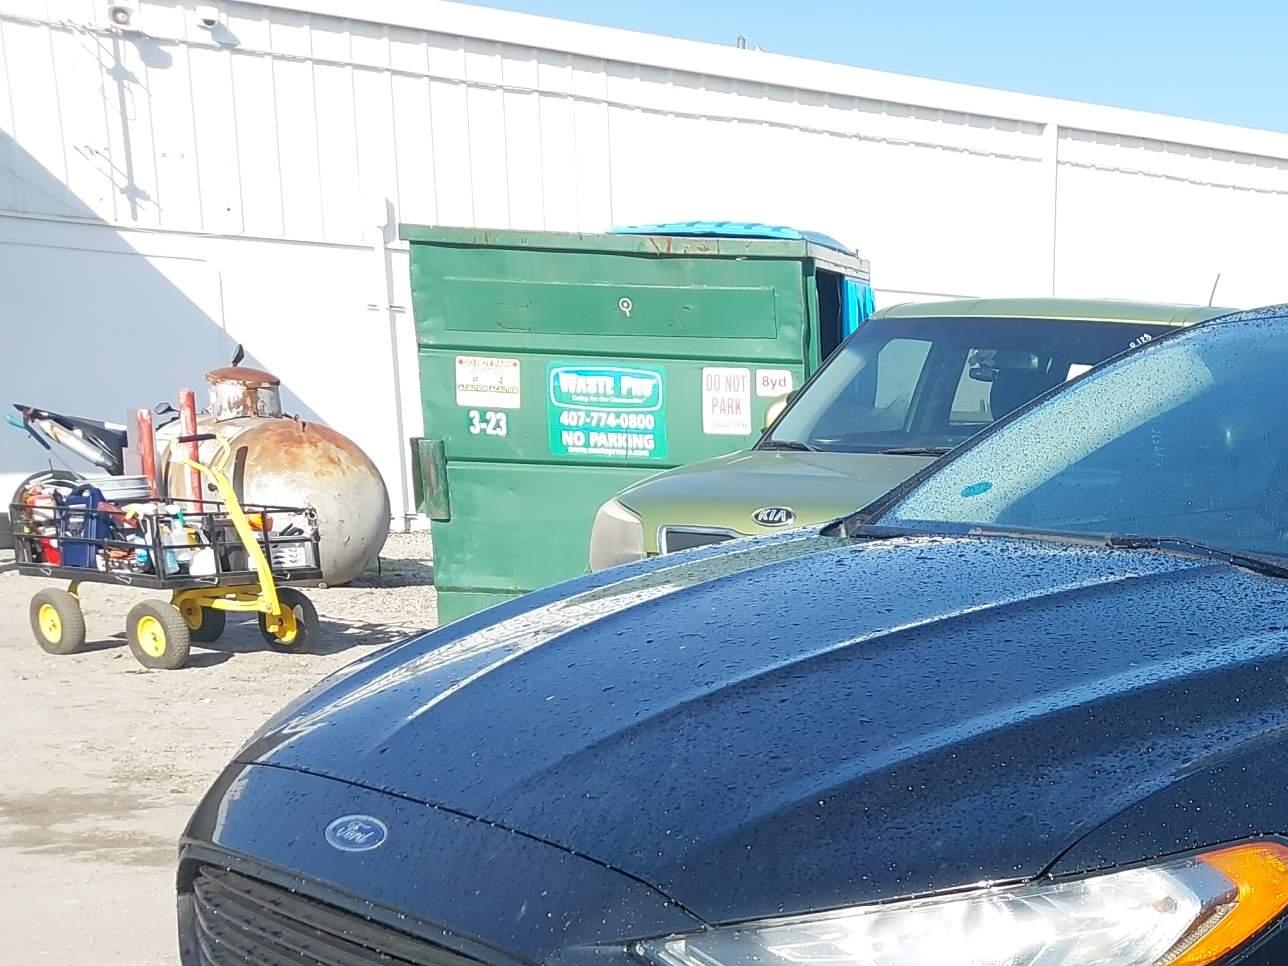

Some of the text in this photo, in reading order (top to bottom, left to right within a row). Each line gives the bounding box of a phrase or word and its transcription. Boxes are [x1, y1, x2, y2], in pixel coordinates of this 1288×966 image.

[706, 374, 747, 393] DO NOT
[762, 375, 787, 390] 8yd
[711, 397, 742, 415] PARK
[469, 410, 507, 436] 3-23
[559, 410, 655, 429] 407-774-0800
[561, 430, 655, 450] NO PARKING
[758, 509, 786, 521] KIA
[335, 821, 375, 844] Ford
